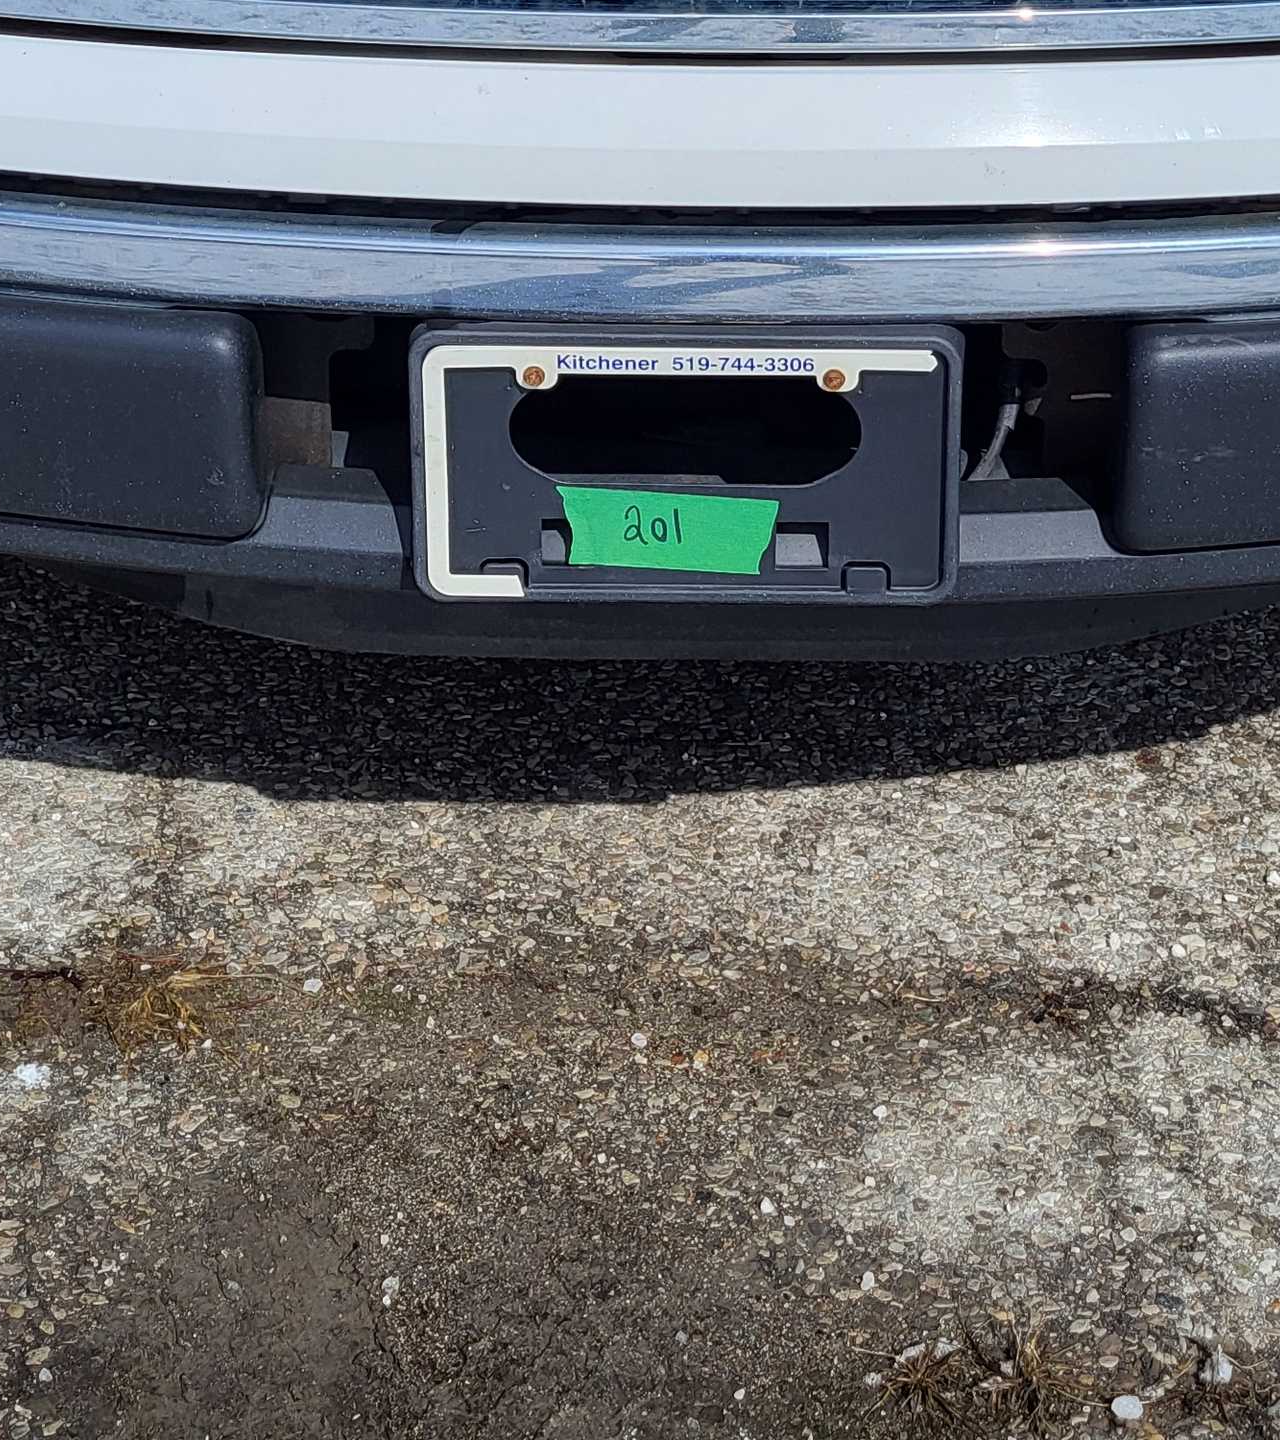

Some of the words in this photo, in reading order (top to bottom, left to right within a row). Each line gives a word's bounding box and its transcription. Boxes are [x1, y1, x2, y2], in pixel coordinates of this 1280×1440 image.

[556, 354, 659, 371] Kitchener
[671, 356, 815, 372] 519-744-3306
[623, 504, 682, 546] 201
